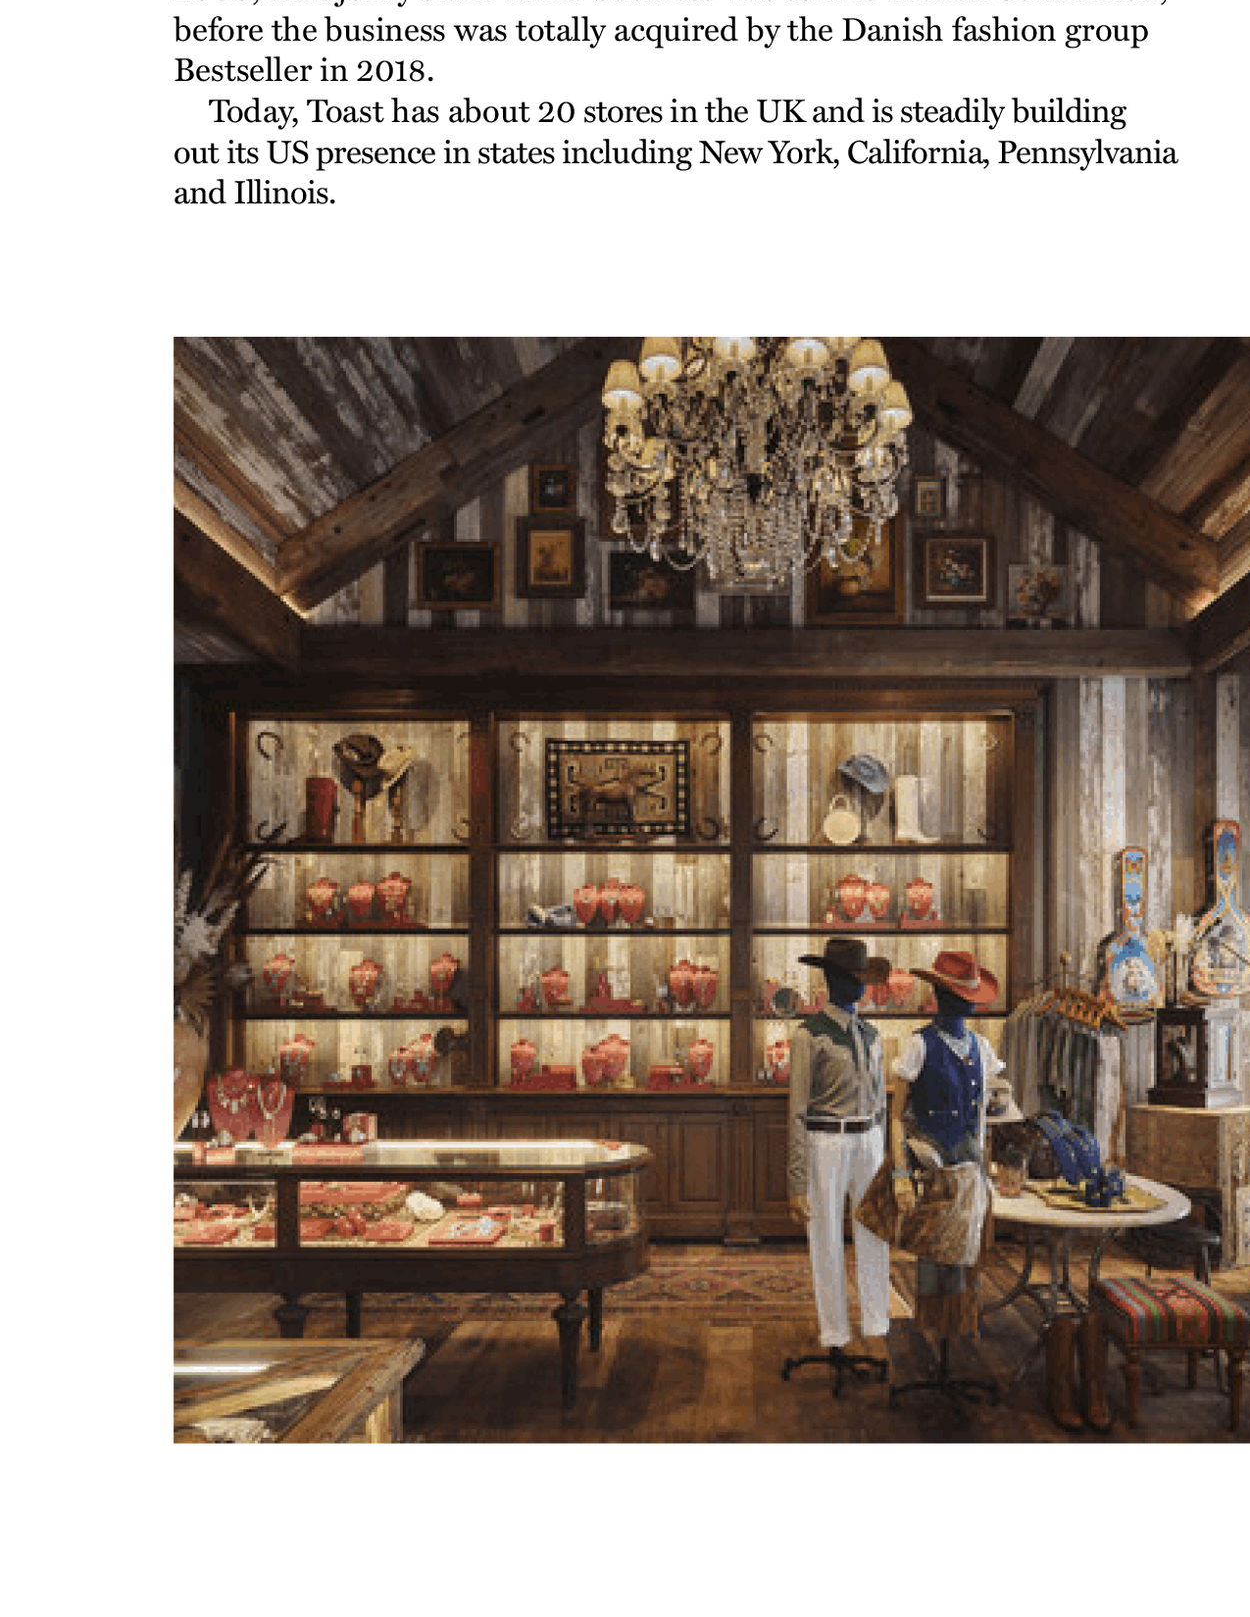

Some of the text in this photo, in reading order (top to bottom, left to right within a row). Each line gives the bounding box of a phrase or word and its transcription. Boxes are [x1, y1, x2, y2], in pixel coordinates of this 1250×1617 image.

[174, 16, 1148, 48] before the business was totally acquired by the Danish fashion group
[175, 179, 335, 204] and Illinois.
